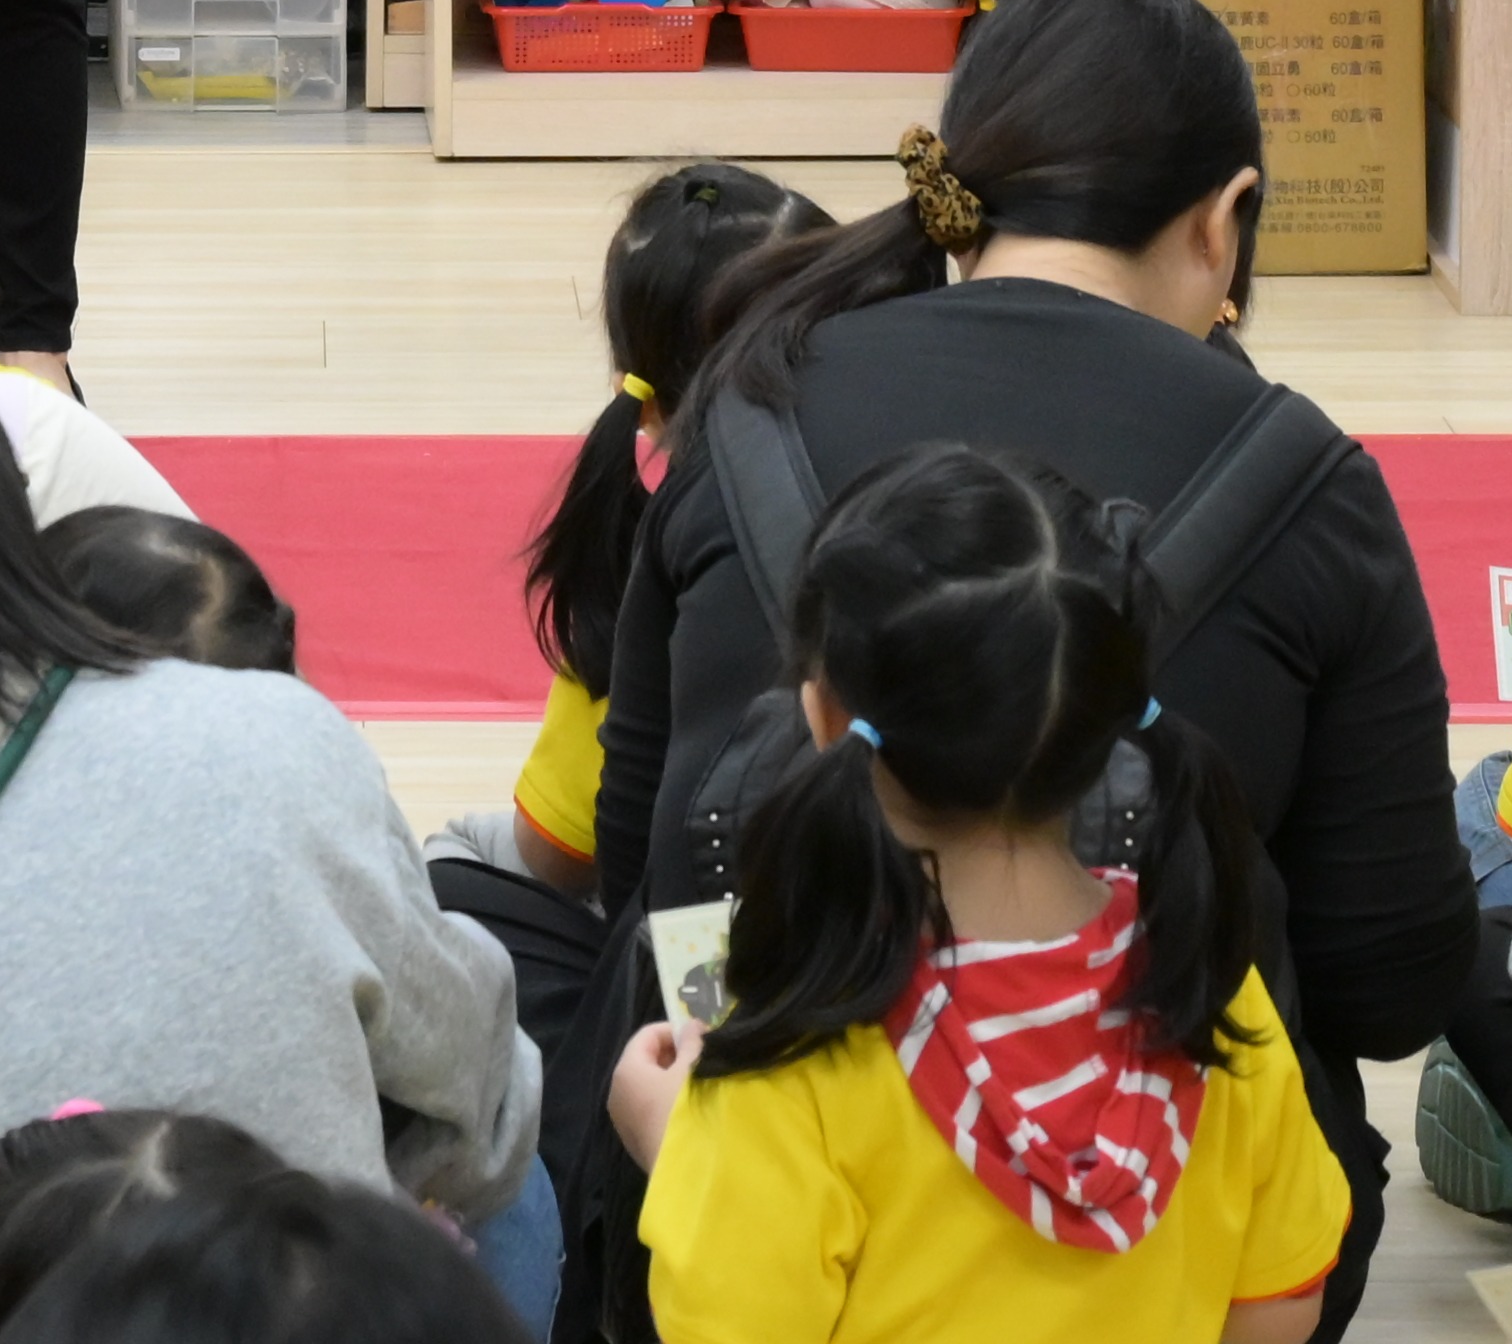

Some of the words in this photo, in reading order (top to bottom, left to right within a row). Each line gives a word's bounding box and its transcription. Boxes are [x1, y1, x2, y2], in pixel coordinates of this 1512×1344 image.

[1267, 177, 1385, 195] 物科技(股)公司
